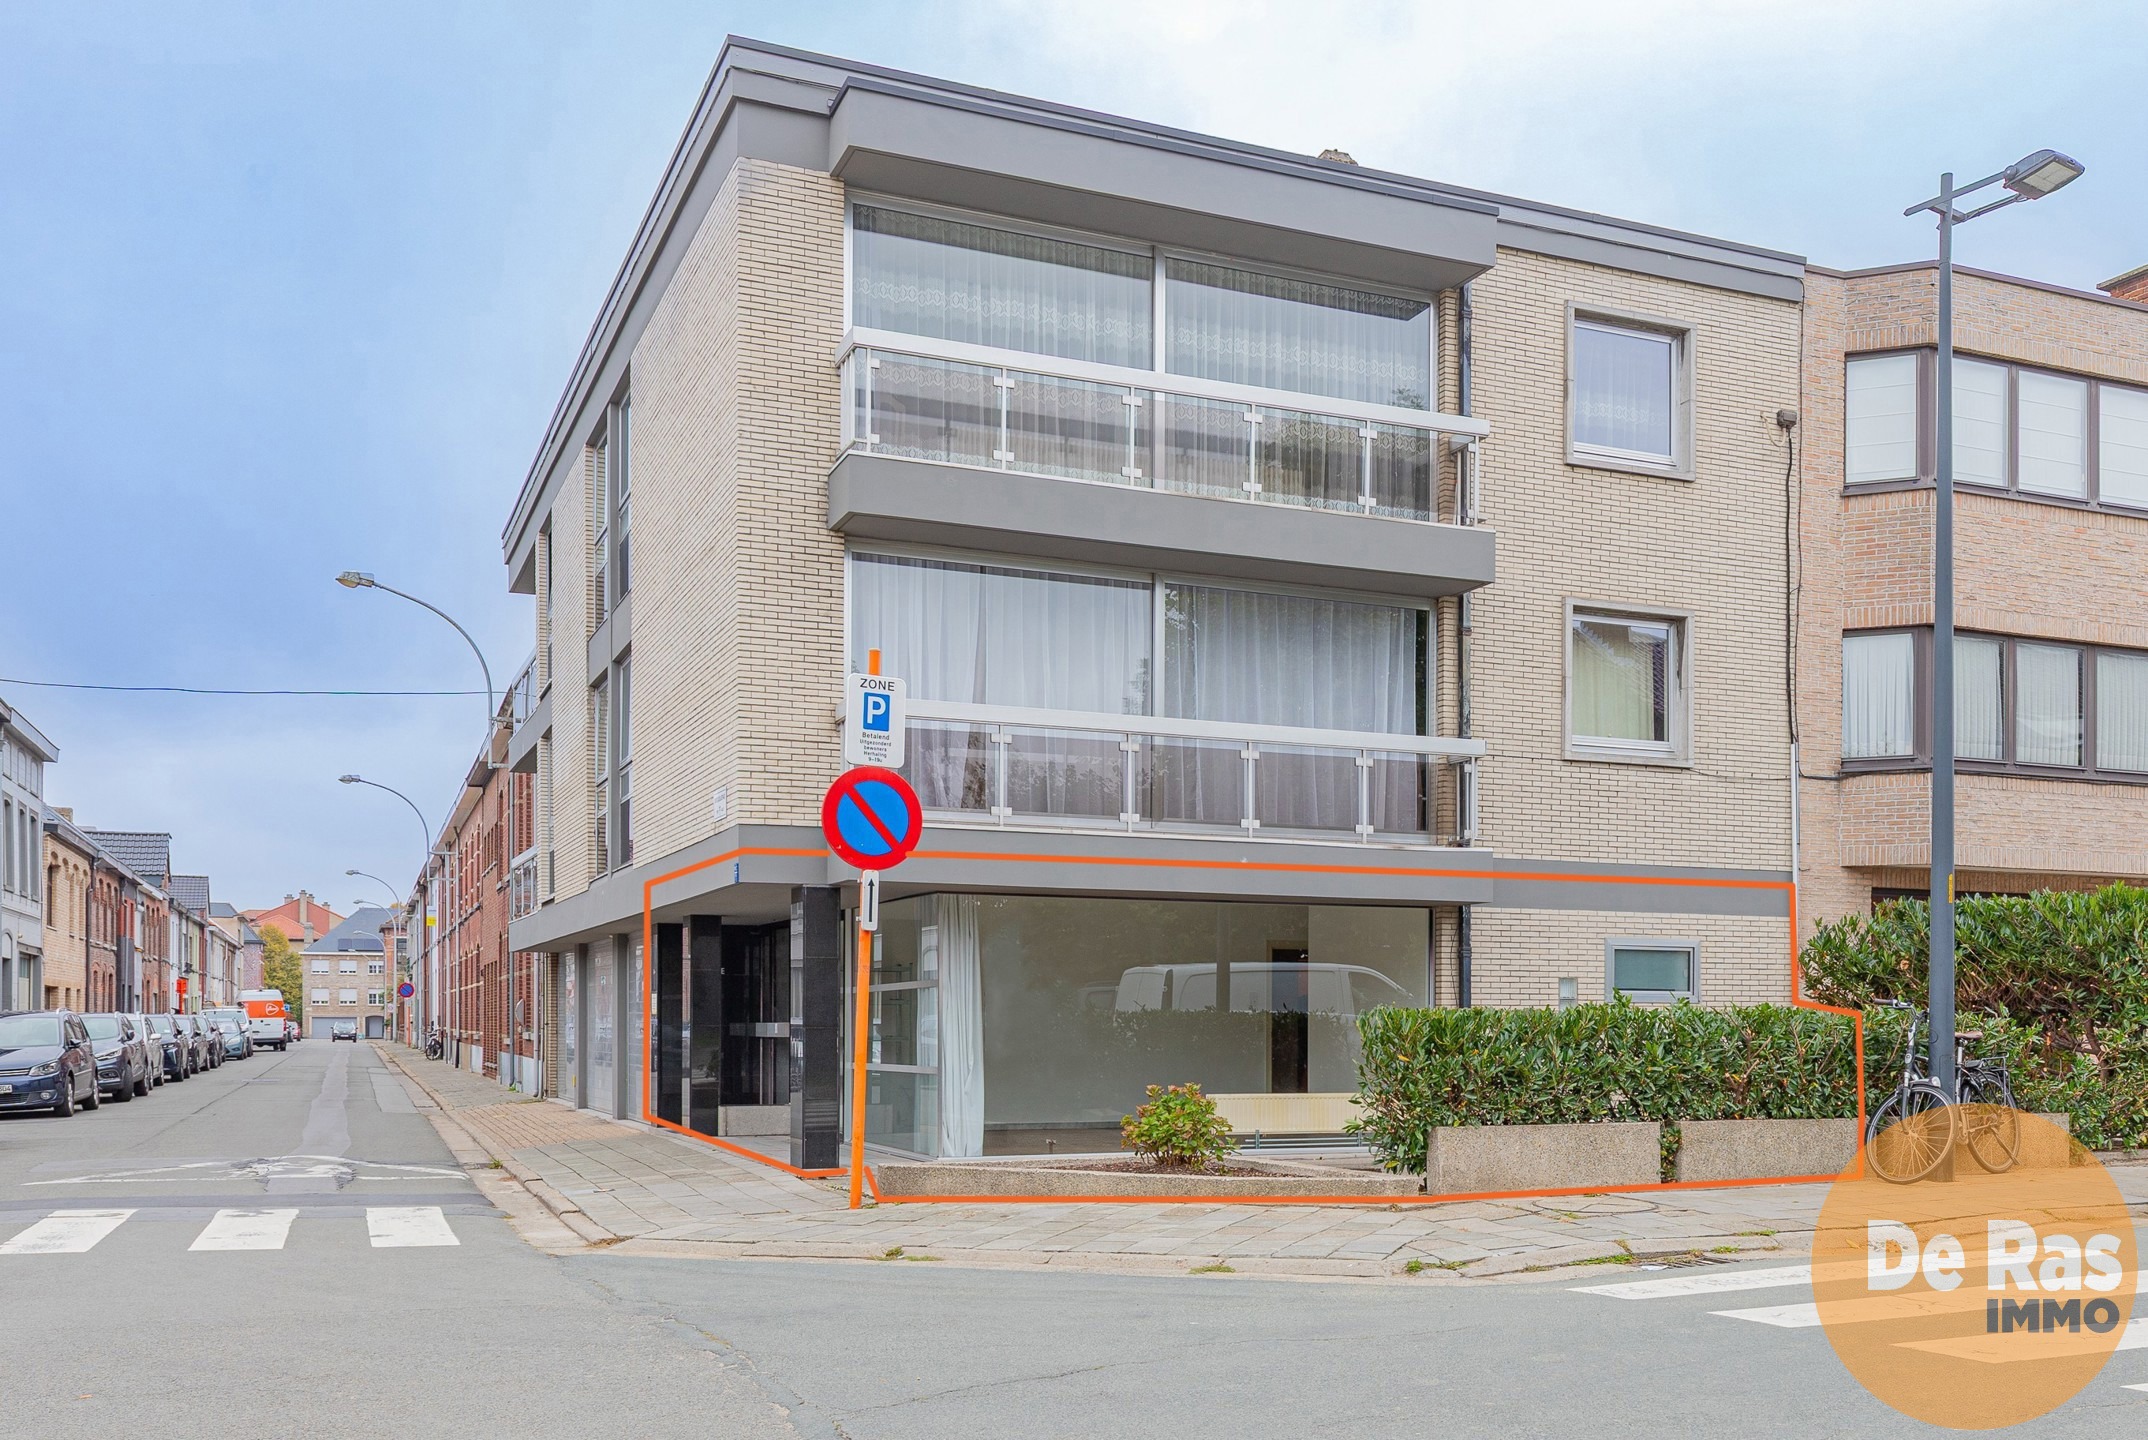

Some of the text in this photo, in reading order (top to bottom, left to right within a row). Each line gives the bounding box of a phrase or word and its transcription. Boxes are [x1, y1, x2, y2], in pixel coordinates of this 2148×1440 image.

[860, 678, 895, 691] ZONE
[867, 696, 886, 724] P
[862, 732, 889, 740] Betalend
